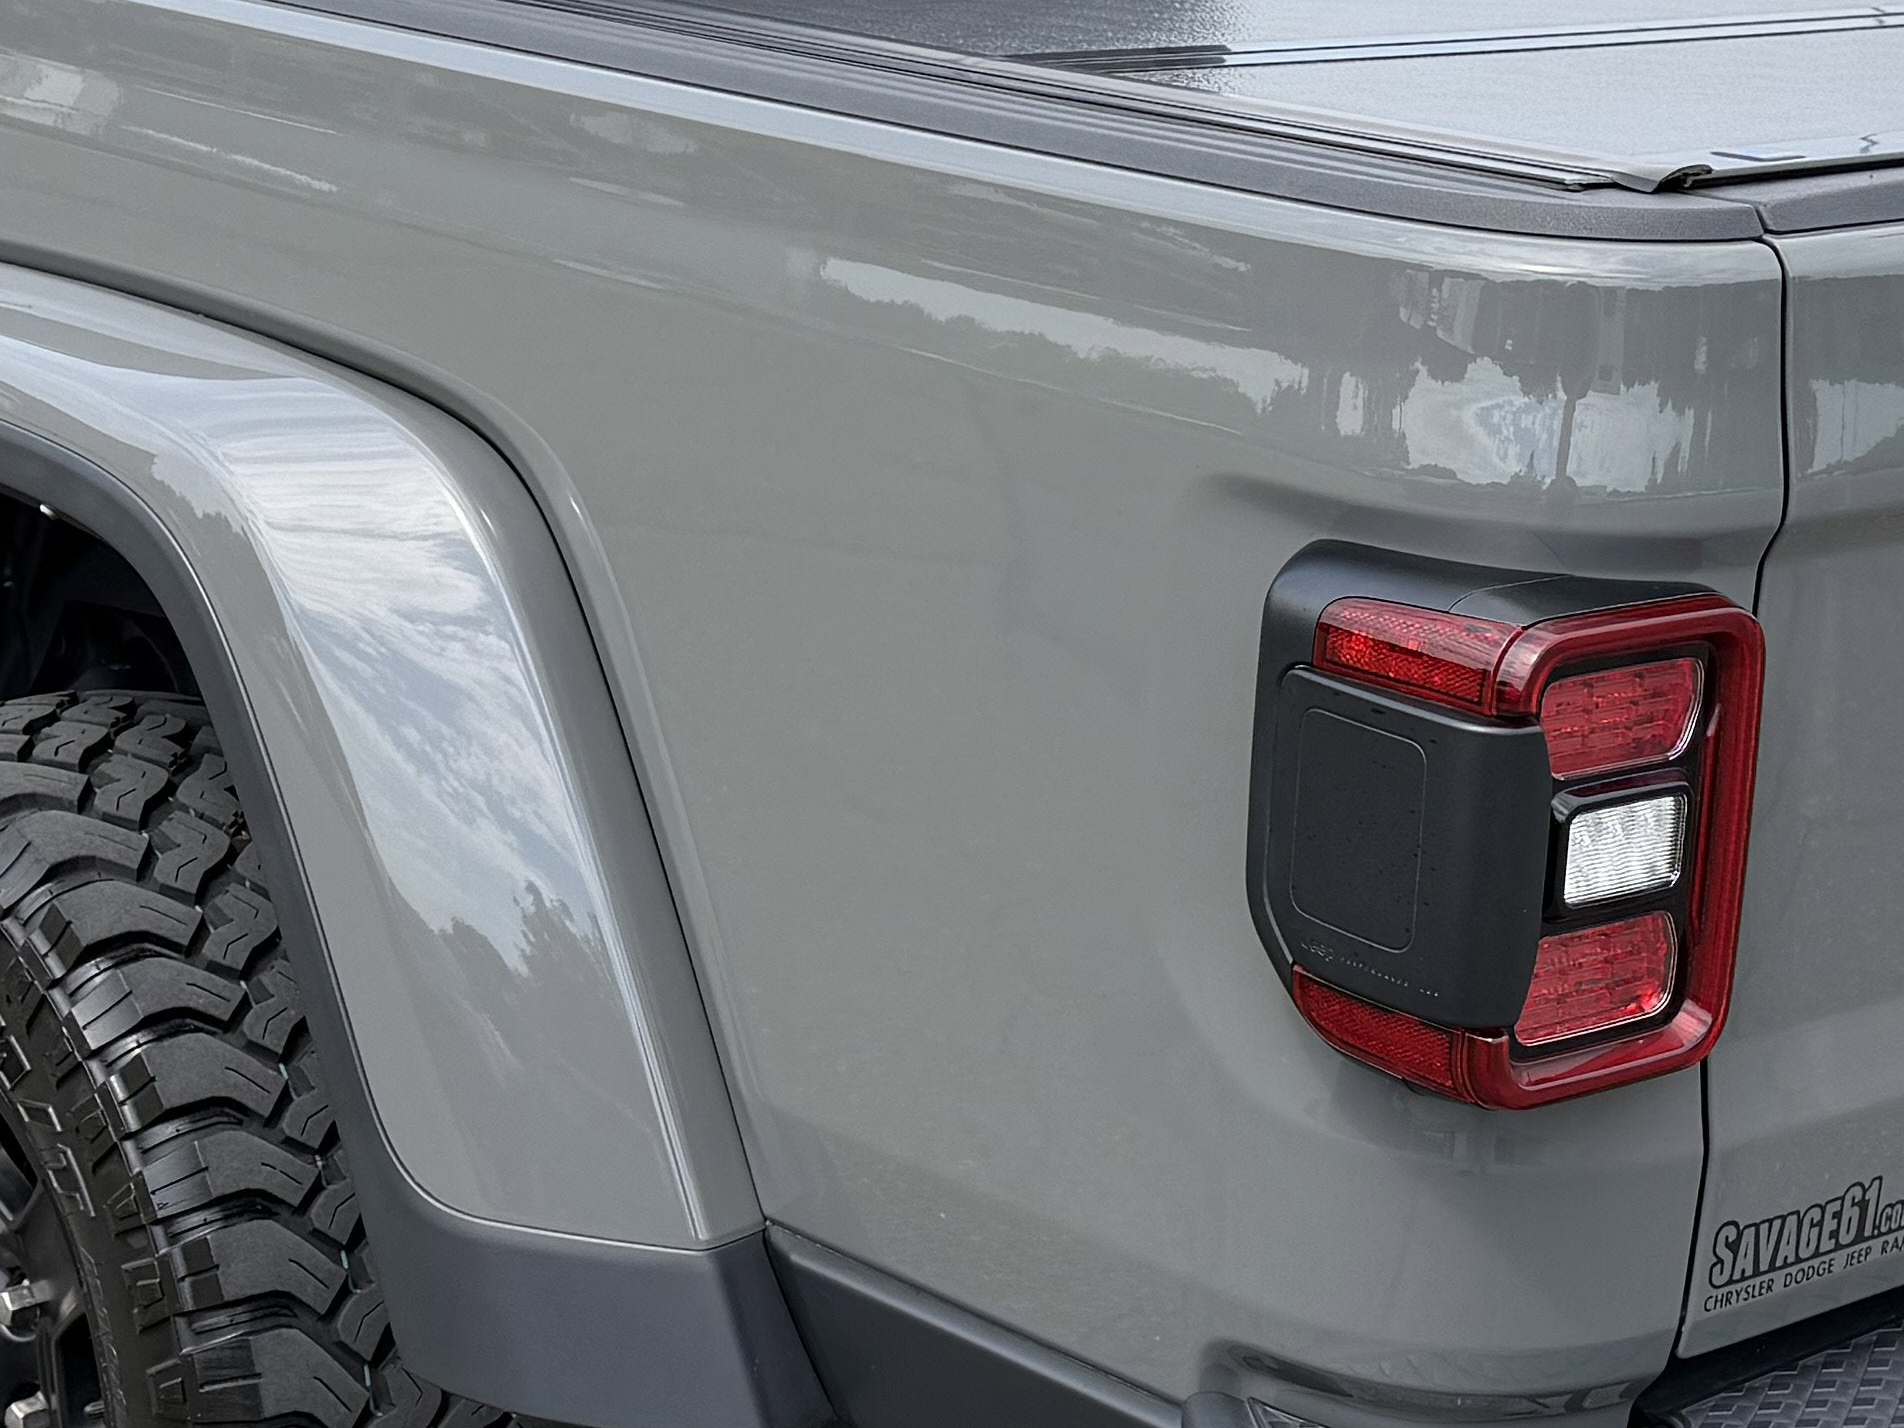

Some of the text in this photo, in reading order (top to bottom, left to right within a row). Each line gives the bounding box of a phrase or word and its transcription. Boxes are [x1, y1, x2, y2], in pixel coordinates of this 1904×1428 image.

[1703, 1278, 1775, 1313] CHRYSLER
[1783, 1259, 1836, 1289] DODGE
[1843, 1247, 1873, 1270] JEEP
